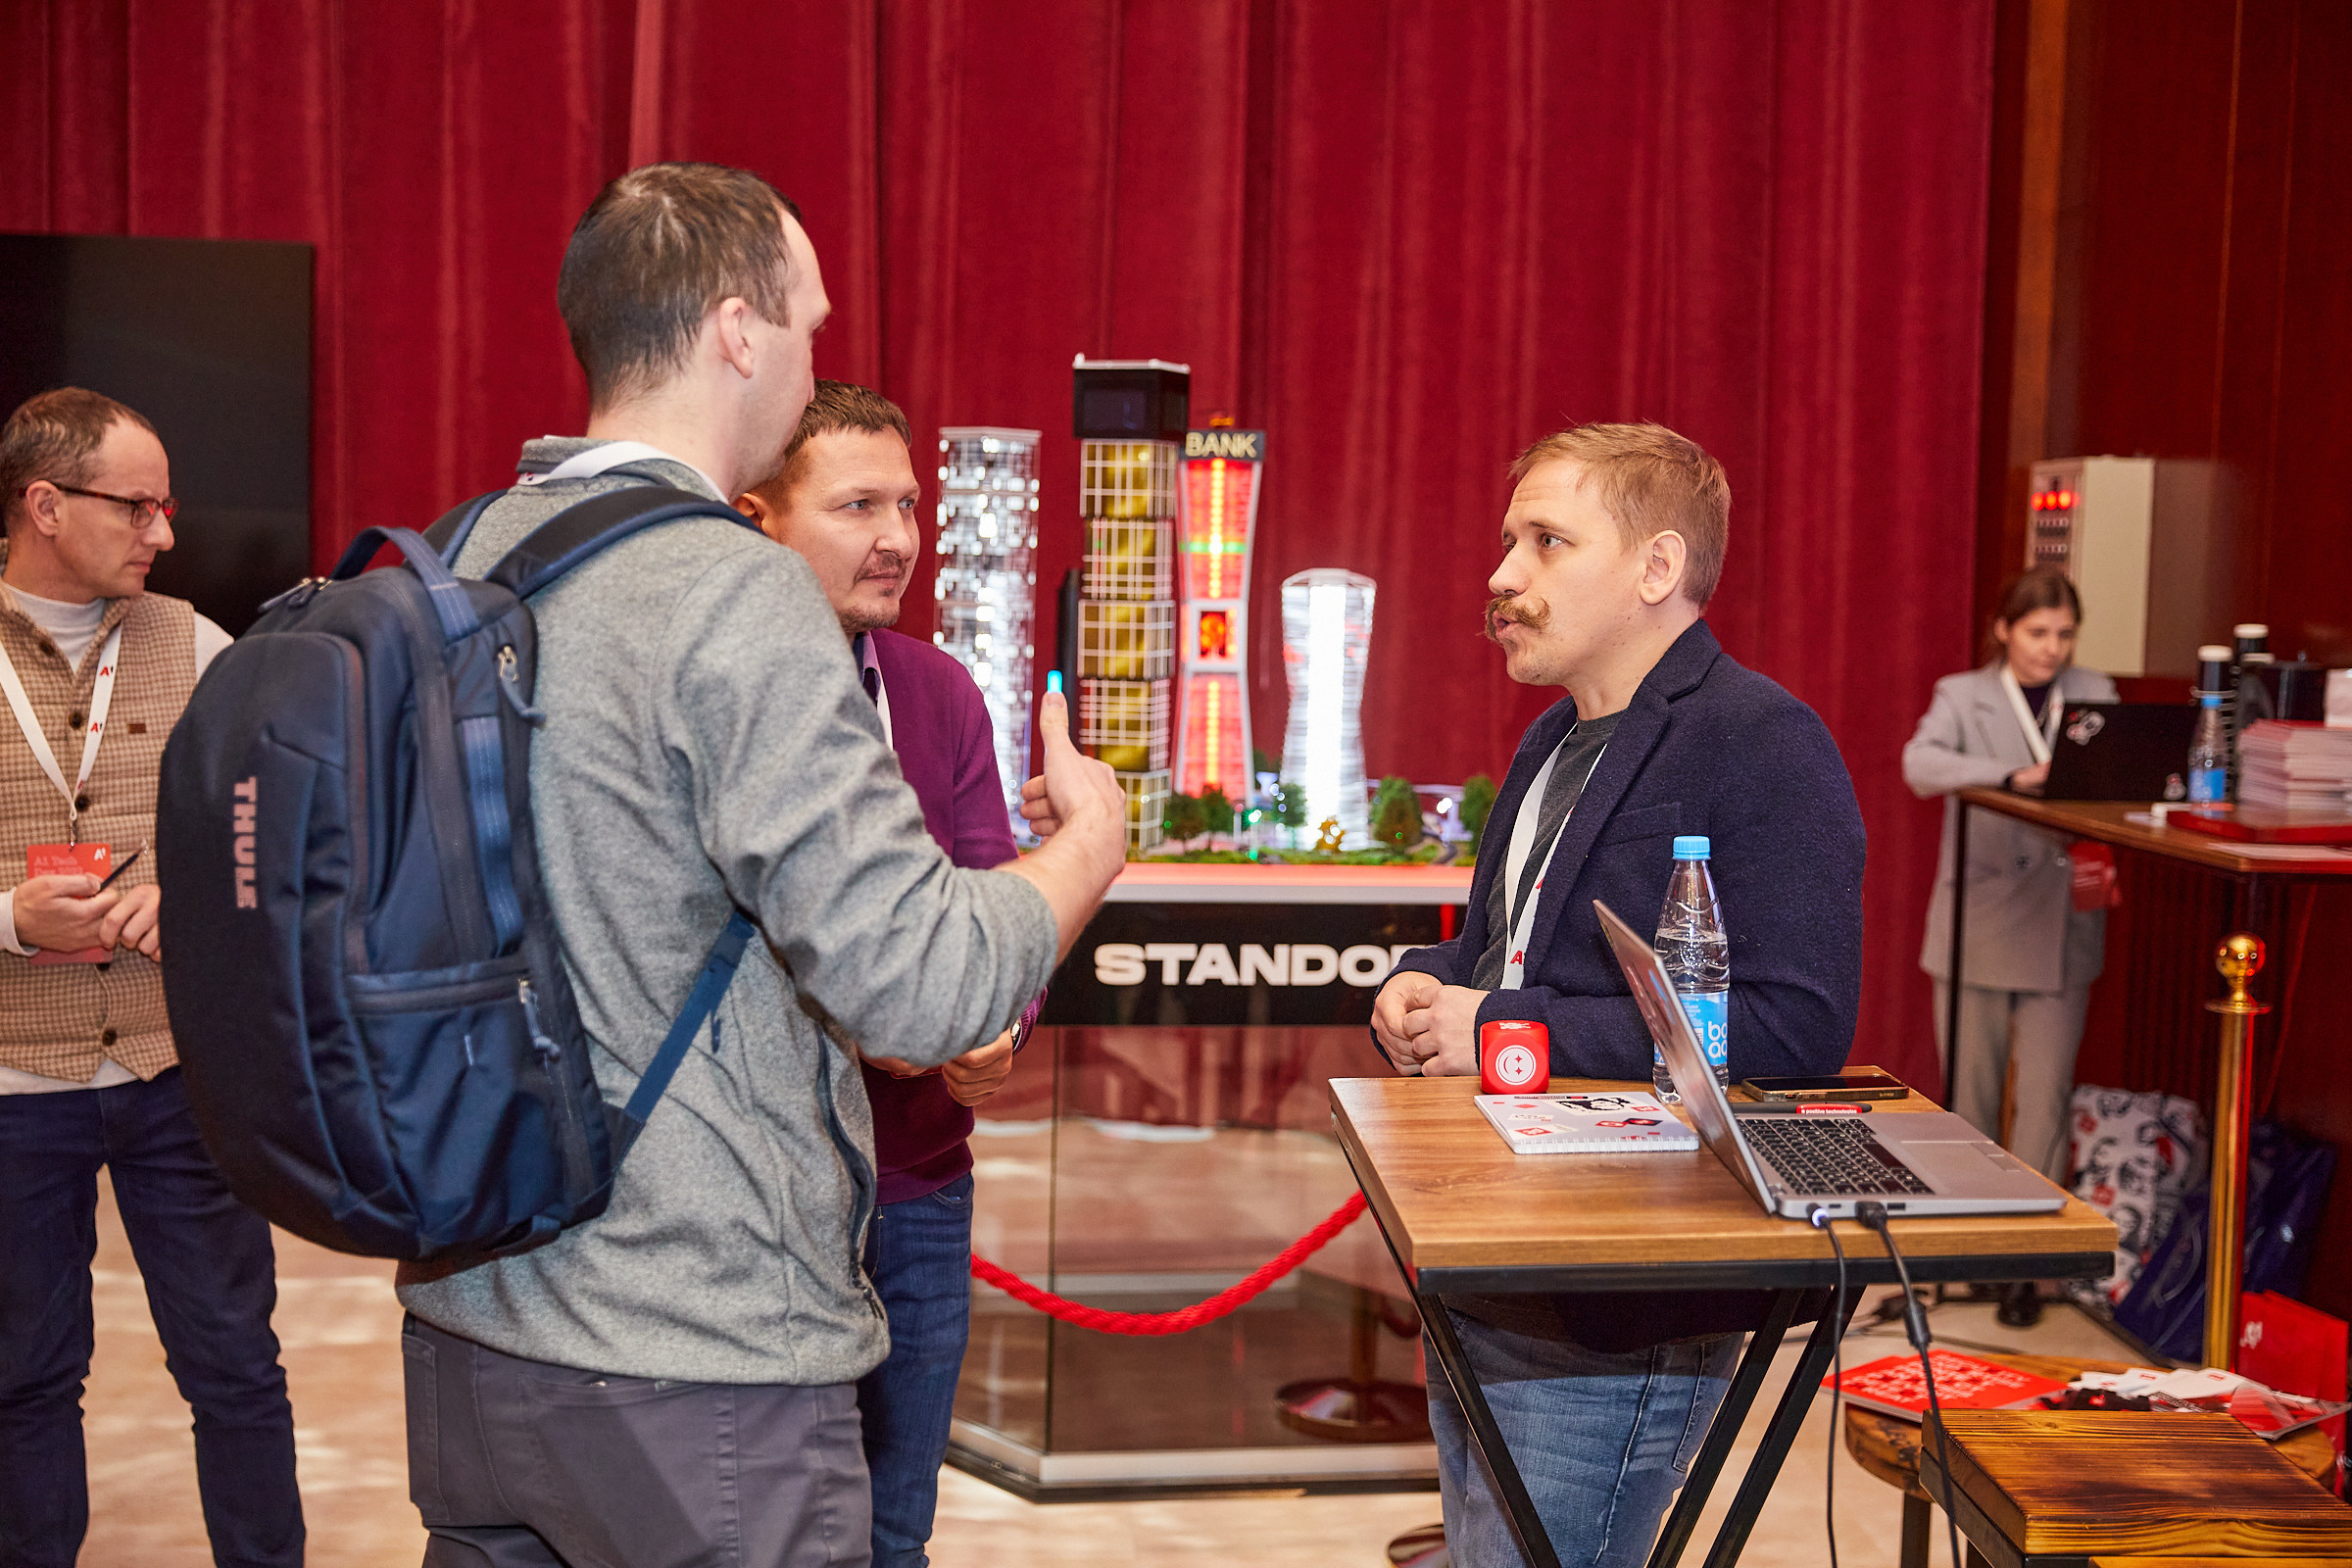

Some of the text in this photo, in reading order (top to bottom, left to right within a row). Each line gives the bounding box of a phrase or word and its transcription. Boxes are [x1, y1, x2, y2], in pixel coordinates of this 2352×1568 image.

[1186, 432, 1256, 459] BANK
[233, 776, 257, 908] THULE
[1094, 943, 1438, 988] STANDO
